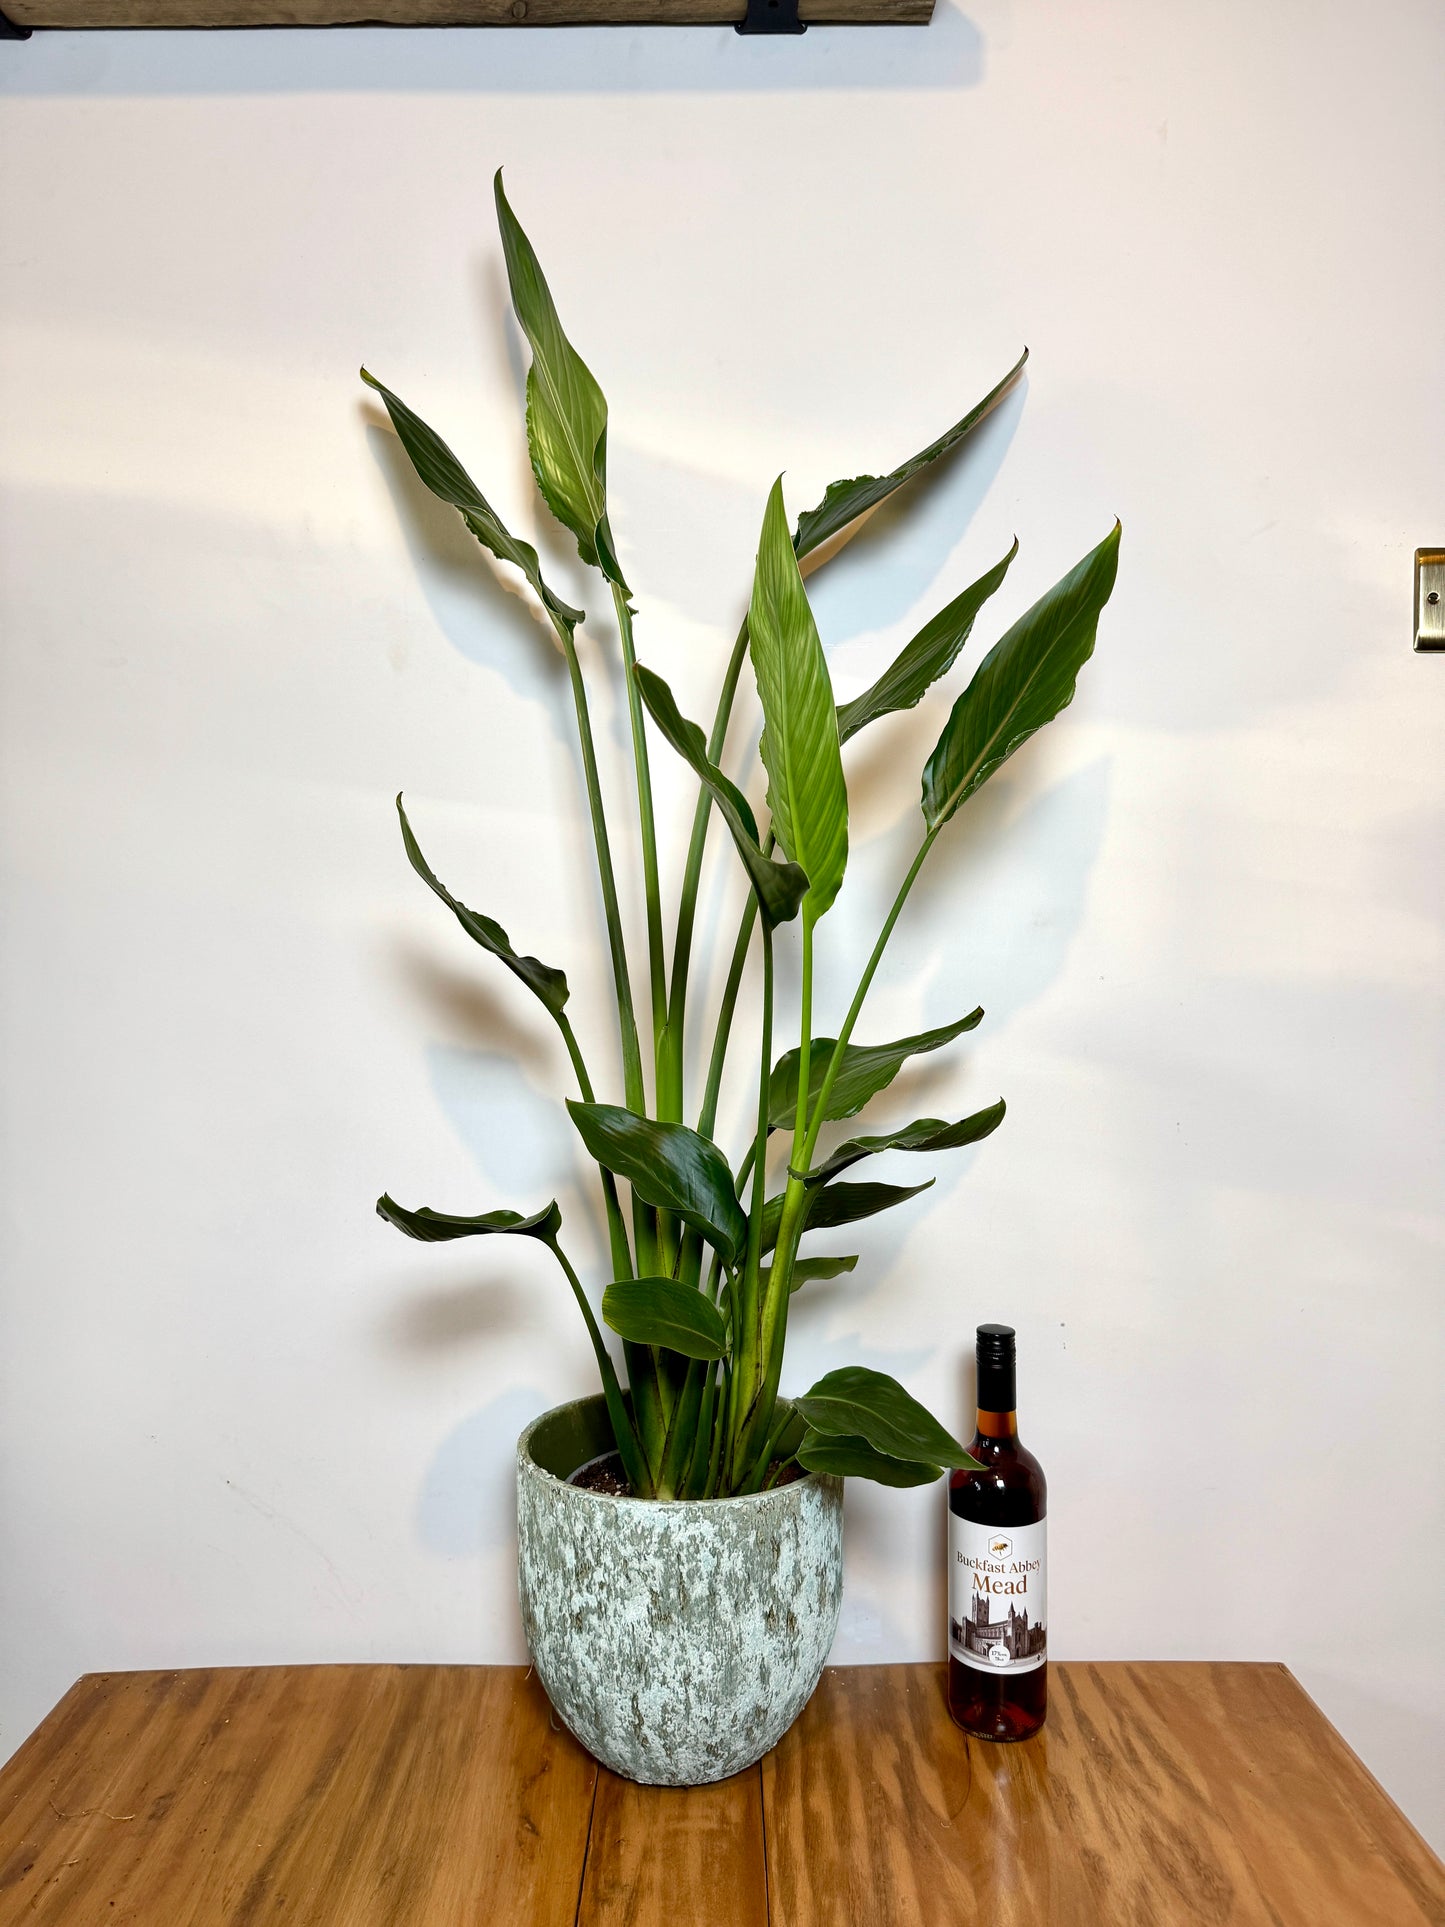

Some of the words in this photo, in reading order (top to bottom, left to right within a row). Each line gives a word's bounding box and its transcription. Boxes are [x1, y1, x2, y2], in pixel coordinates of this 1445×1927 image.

[957, 1551, 1005, 1573] Buckfast
[1009, 1558, 1041, 1575] Abbey
[972, 1573, 1028, 1595] Mead
